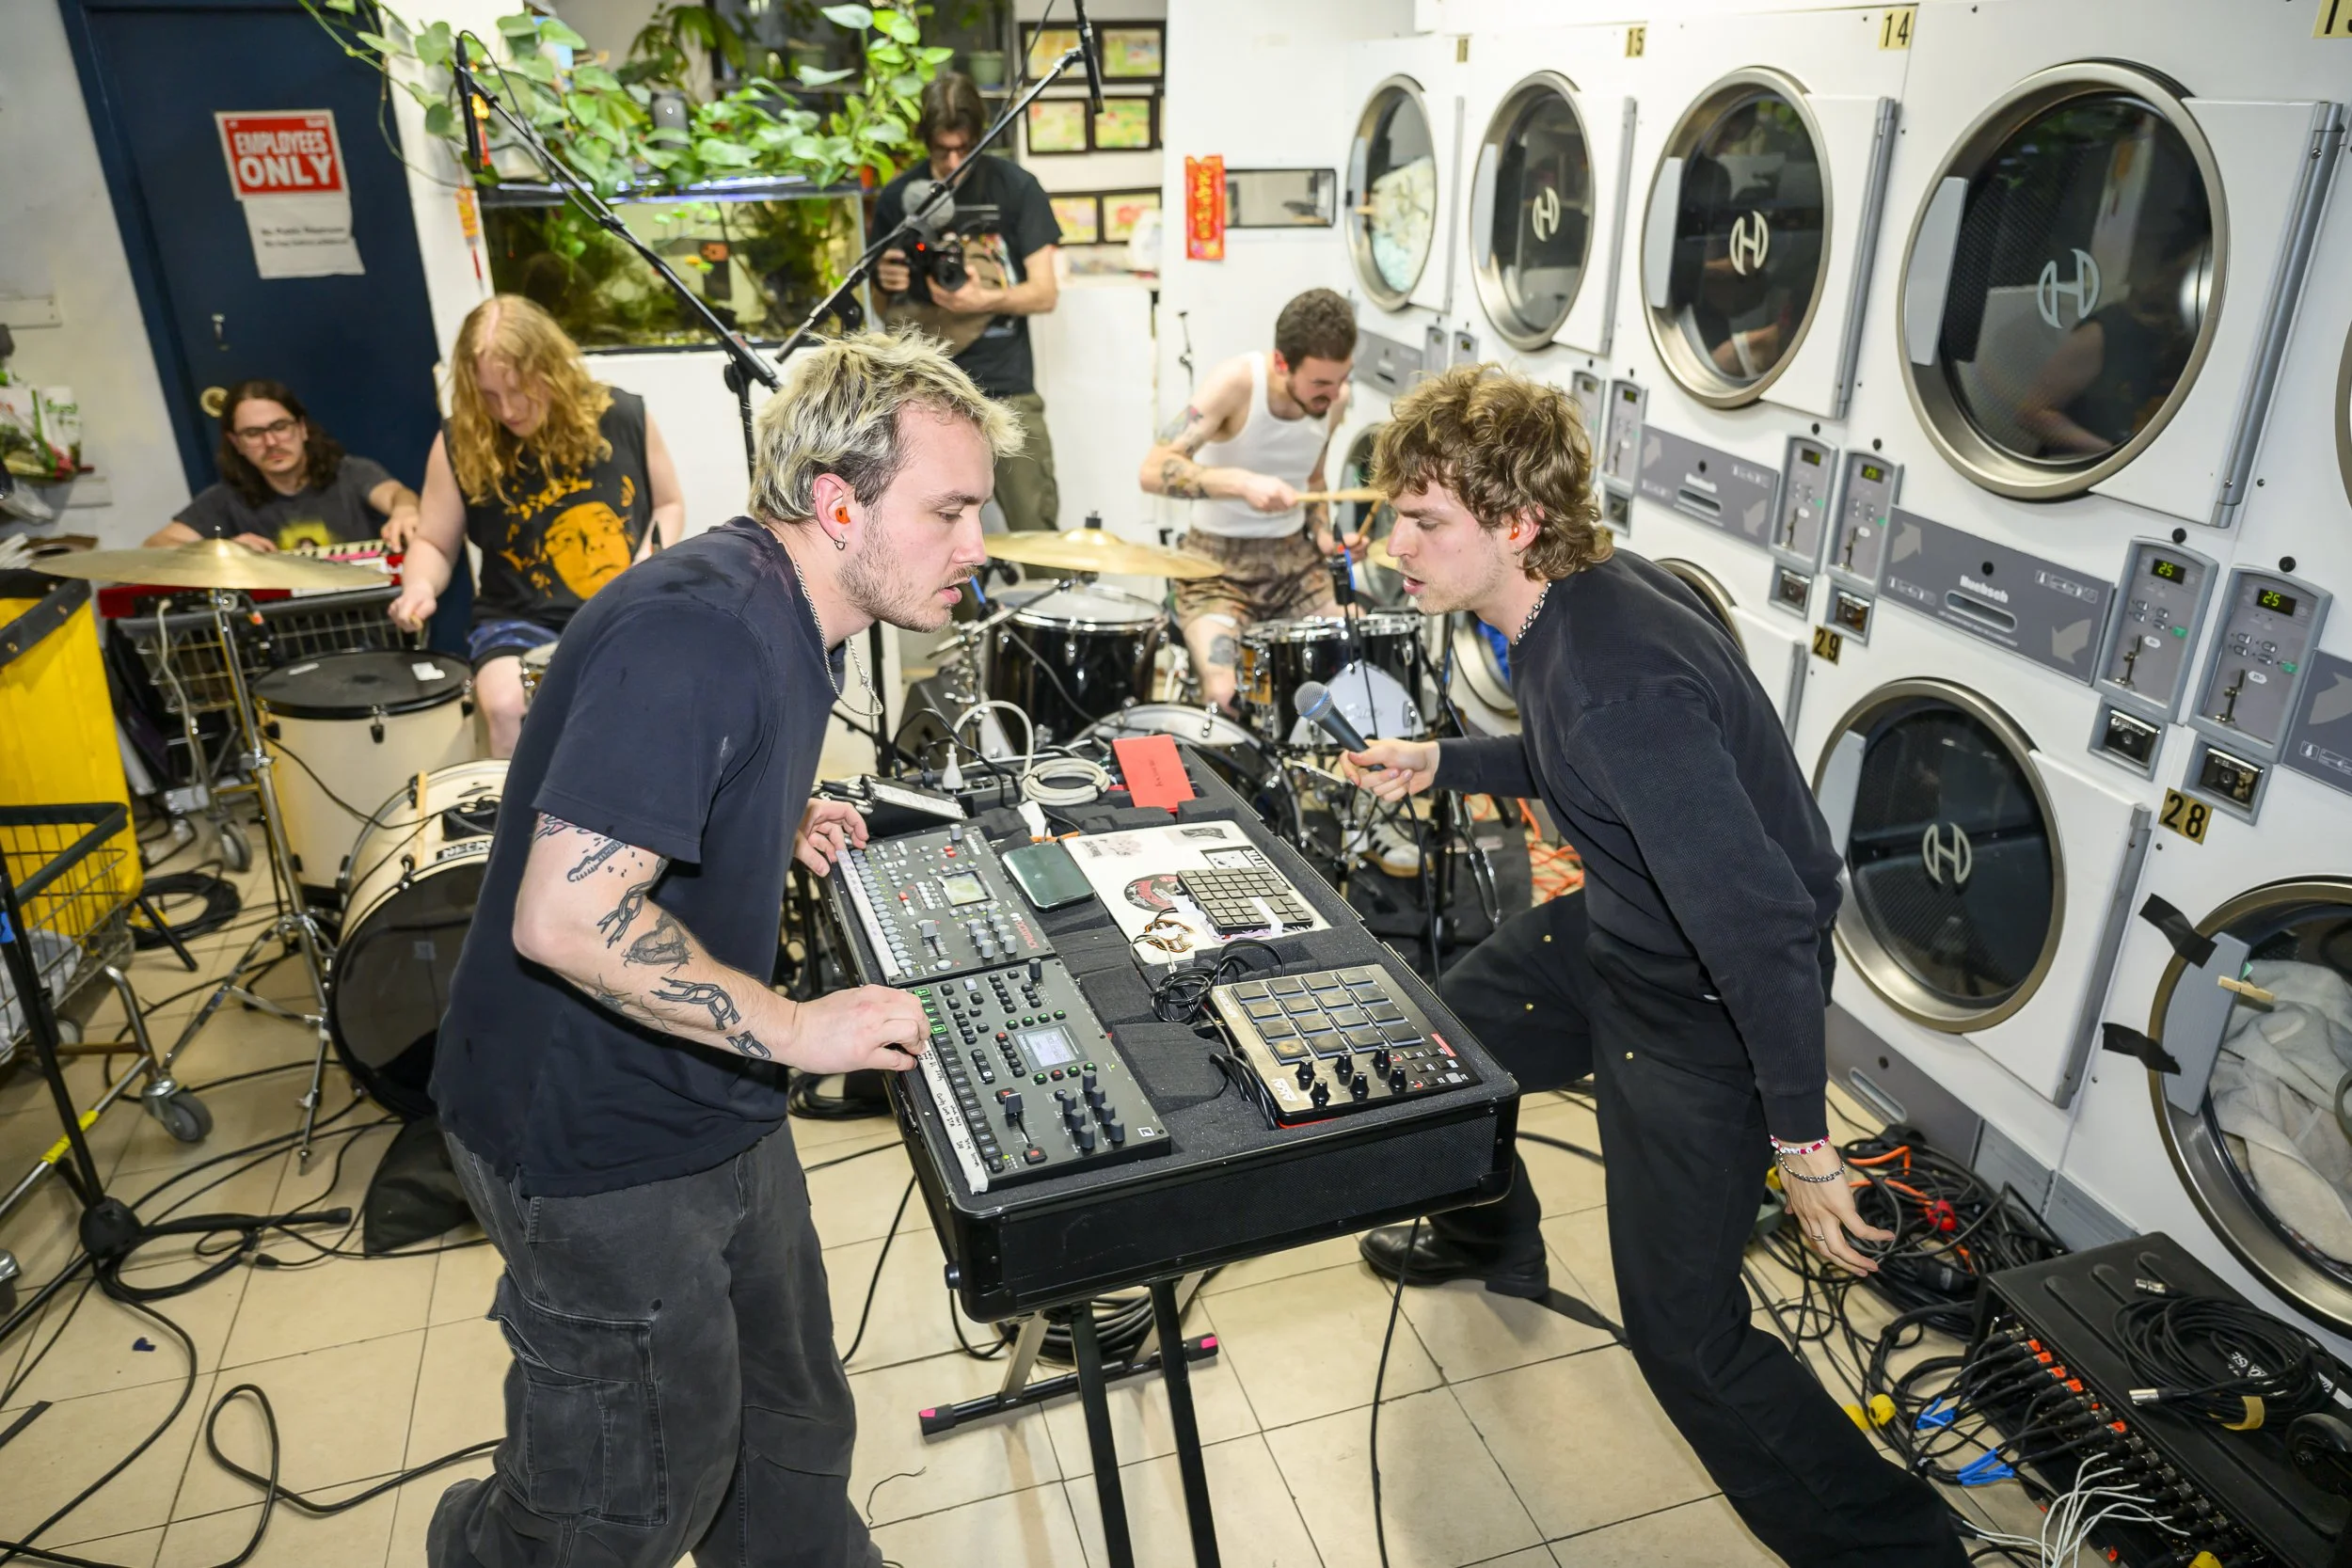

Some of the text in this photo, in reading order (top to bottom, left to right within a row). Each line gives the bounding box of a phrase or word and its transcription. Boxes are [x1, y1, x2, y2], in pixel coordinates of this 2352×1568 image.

[1628, 28, 1644, 56] 15
[1884, 11, 1911, 47] 14
[234, 130, 328, 155] EMPLOYEES
[238, 154, 331, 187] ONLY
[2157, 562, 2173, 577] 25
[2263, 591, 2280, 607] 25
[1813, 628, 1840, 661] 29
[2164, 793, 2206, 839] 28
